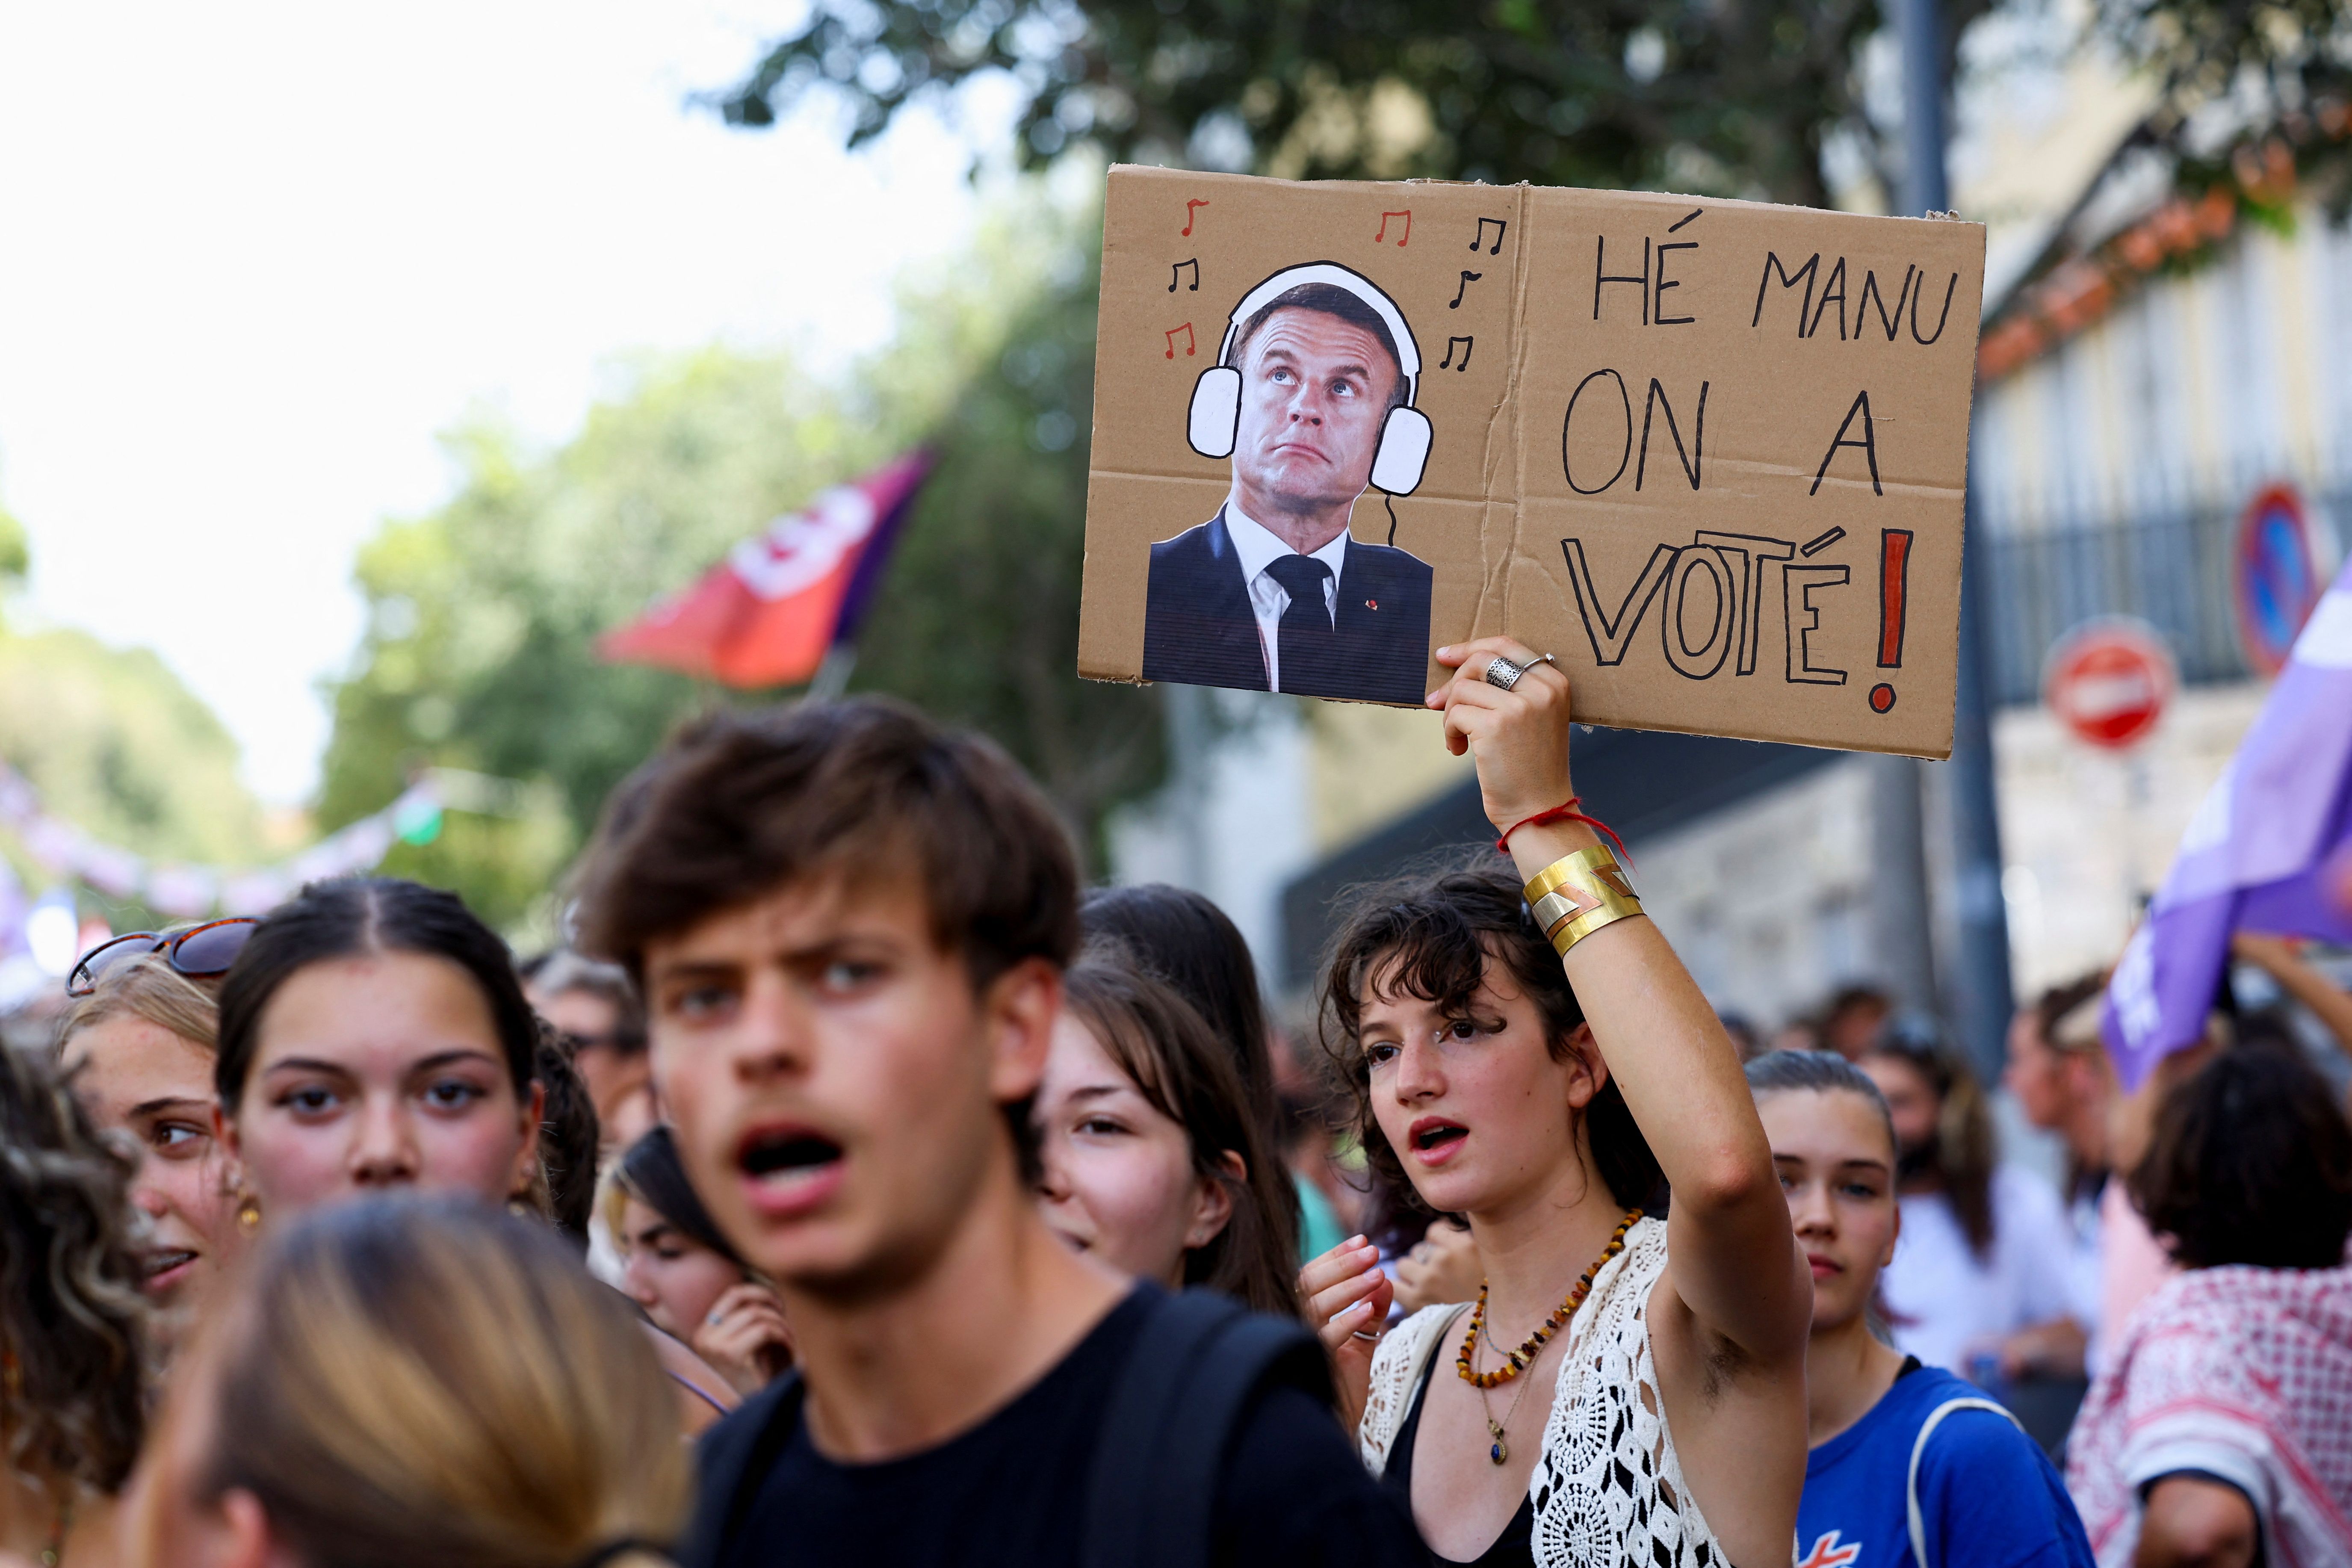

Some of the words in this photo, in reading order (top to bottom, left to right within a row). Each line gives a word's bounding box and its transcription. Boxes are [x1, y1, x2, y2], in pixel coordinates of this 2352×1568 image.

[1593, 209, 1702, 325] HÉ
[1752, 251, 1958, 345] MANU
[1562, 368, 1709, 495] ON
[1809, 390, 1883, 496] A
[1560, 526, 1913, 714] VOTÉ!
